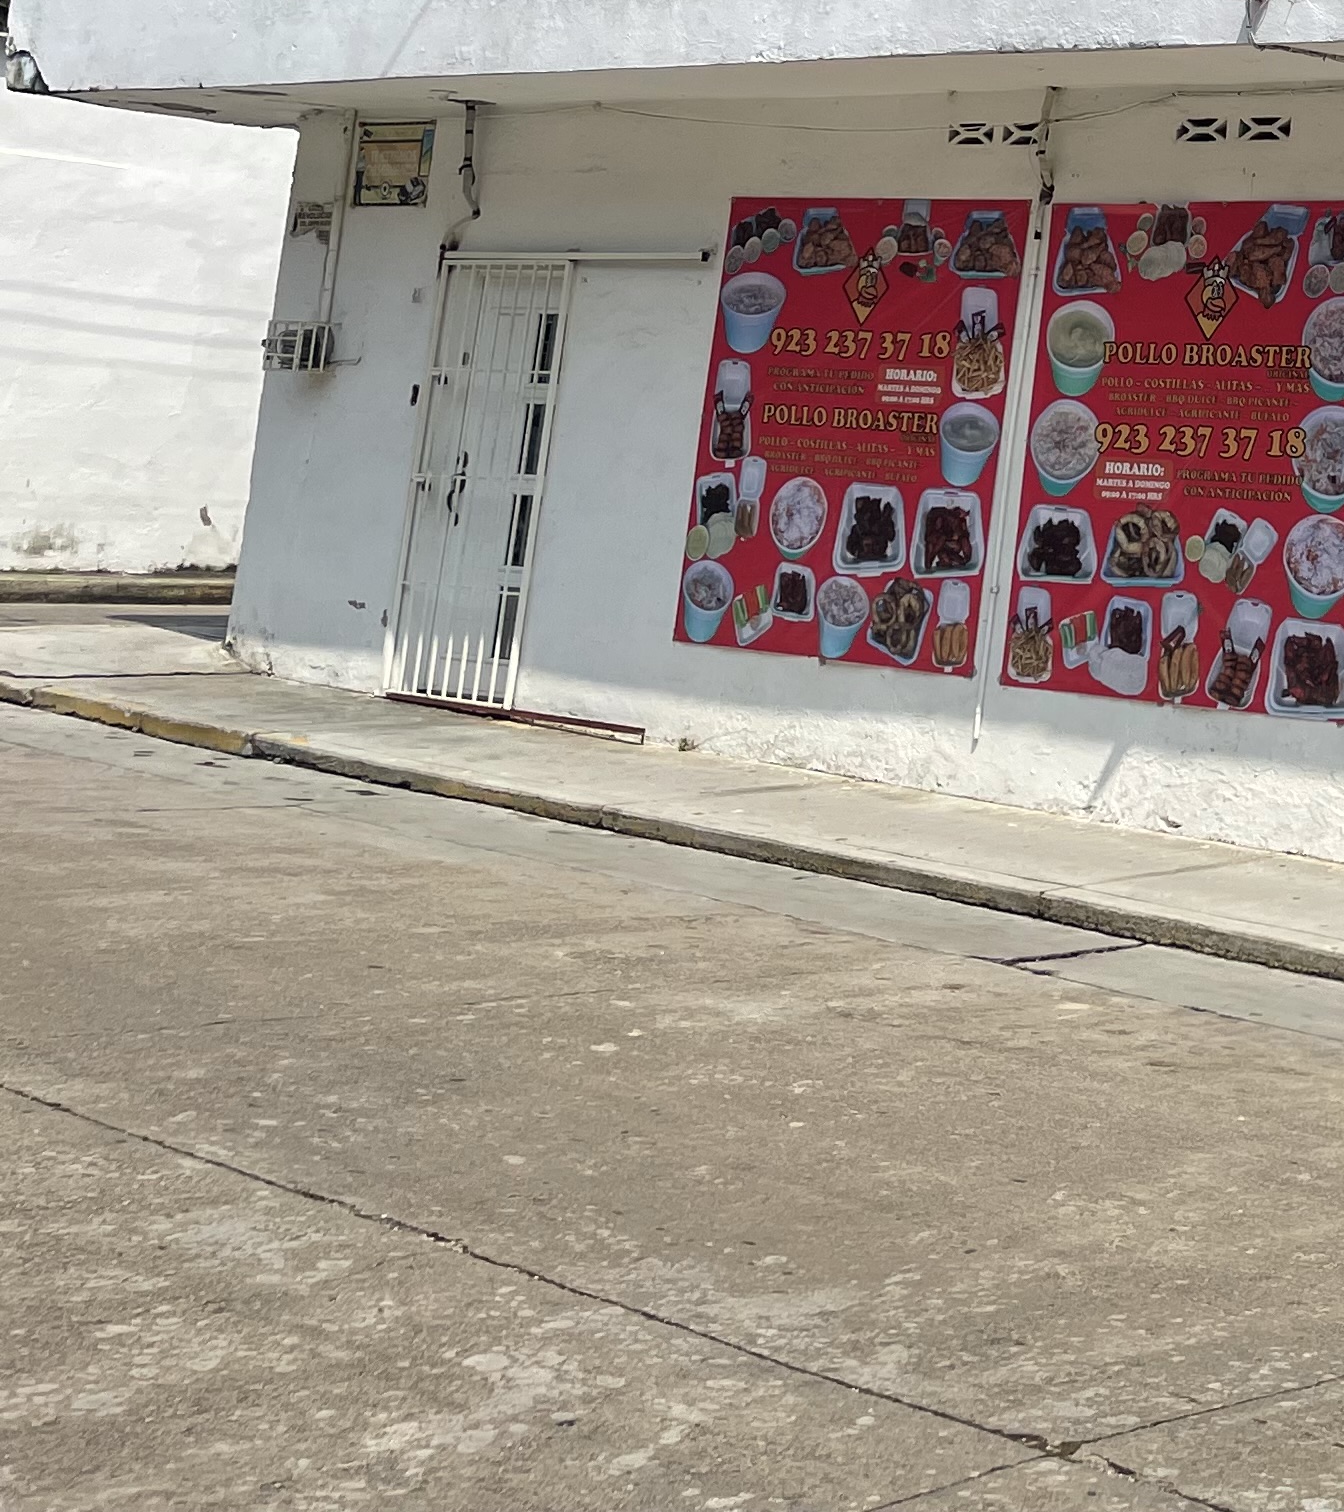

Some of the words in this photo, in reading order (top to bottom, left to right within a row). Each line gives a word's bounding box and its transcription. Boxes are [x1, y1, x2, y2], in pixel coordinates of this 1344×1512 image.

[770, 327, 818, 356] 923
[823, 329, 874, 360] 237
[878, 331, 912, 361] 37
[917, 331, 952, 359] 18
[1103, 341, 1178, 364] POLLO
[1182, 344, 1312, 369] BROASTER
[885, 369, 938, 381] HORARIO:
[1102, 377, 1133, 387] POLLO
[1144, 378, 1204, 389] COSTILLAS
[762, 404, 828, 427] POLLO
[832, 407, 939, 435] BROASTER
[1095, 422, 1150, 454] 923
[1158, 425, 1215, 458] 237
[1218, 427, 1258, 461] 37
[1266, 427, 1307, 458] 18
[1104, 461, 1165, 476] HORARIO:
[1096, 479, 1127, 487] MARTES
[1134, 480, 1171, 489] DOMINGO
[1177, 469, 1237, 483] PROGRAMA
[1241, 472, 1256, 484] TU
[1183, 486, 1205, 496] CON
